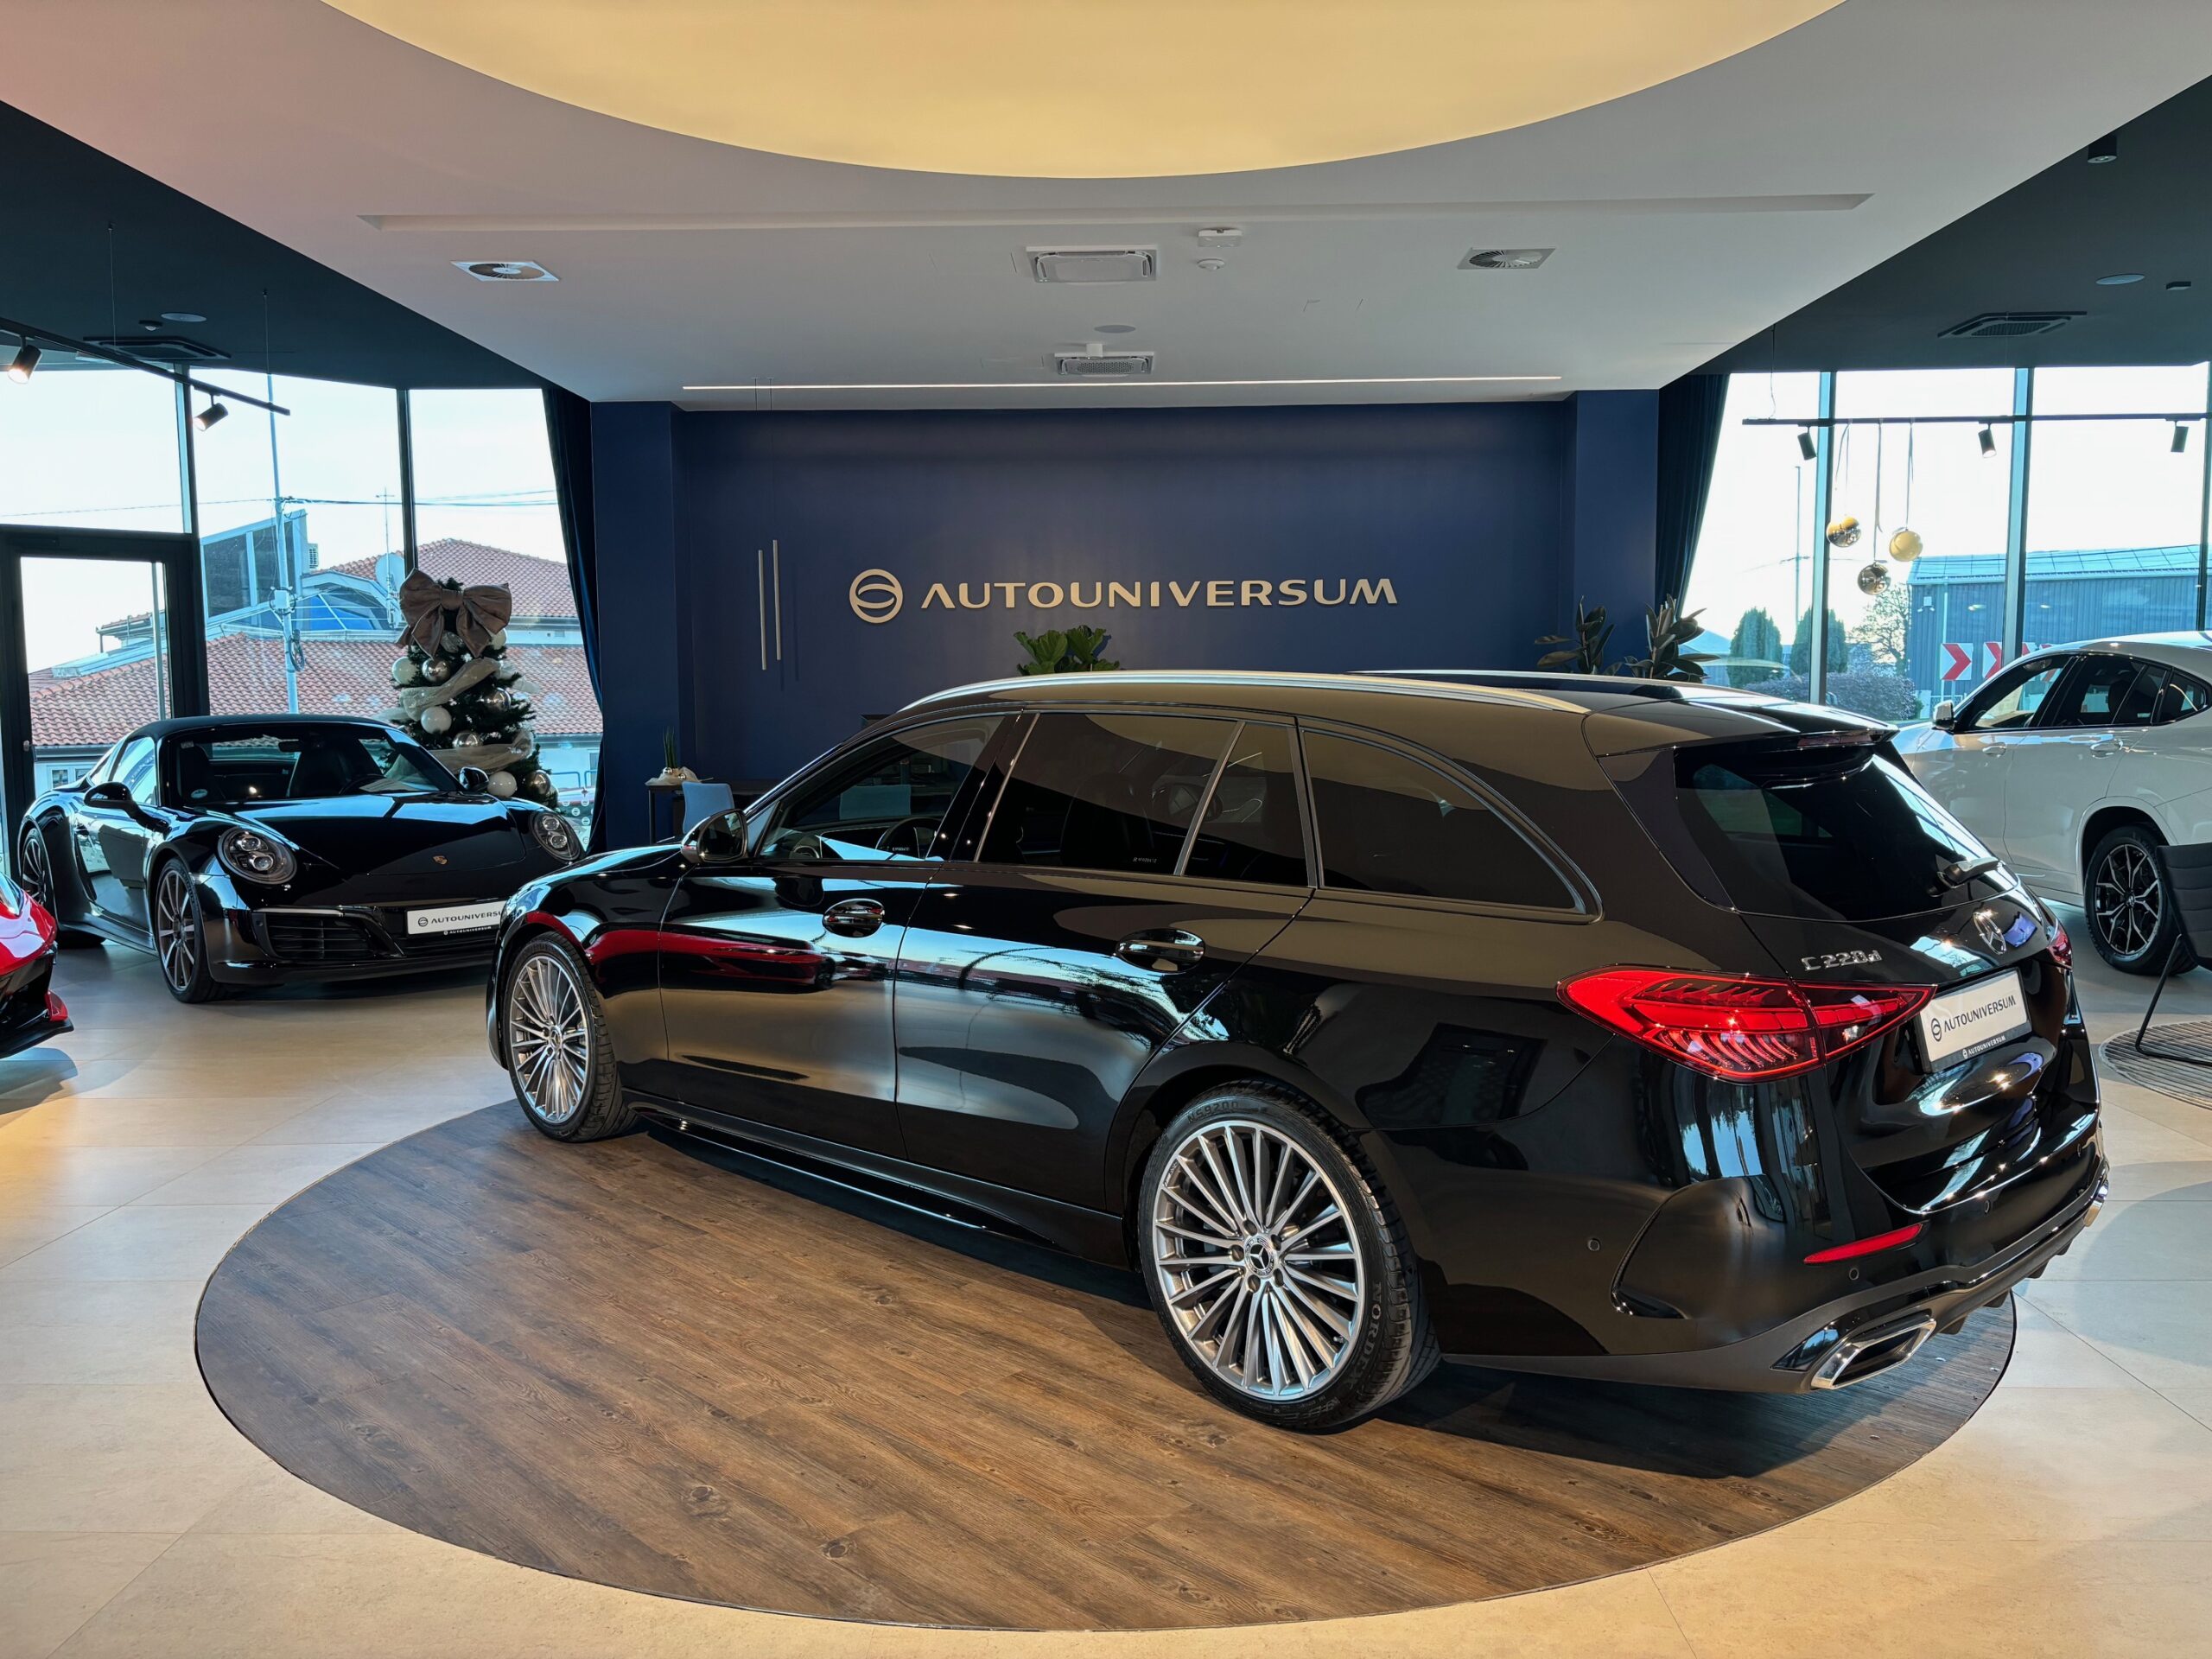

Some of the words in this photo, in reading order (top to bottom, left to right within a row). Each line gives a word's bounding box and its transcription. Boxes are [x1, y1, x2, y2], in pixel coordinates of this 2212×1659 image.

[921, 578, 1397, 609] AUTOUNIVERSUM
[1944, 995, 2017, 1033] AUTOUNIVERSUM
[1968, 1035, 2006, 1055] AUTOUNIVERSUM
